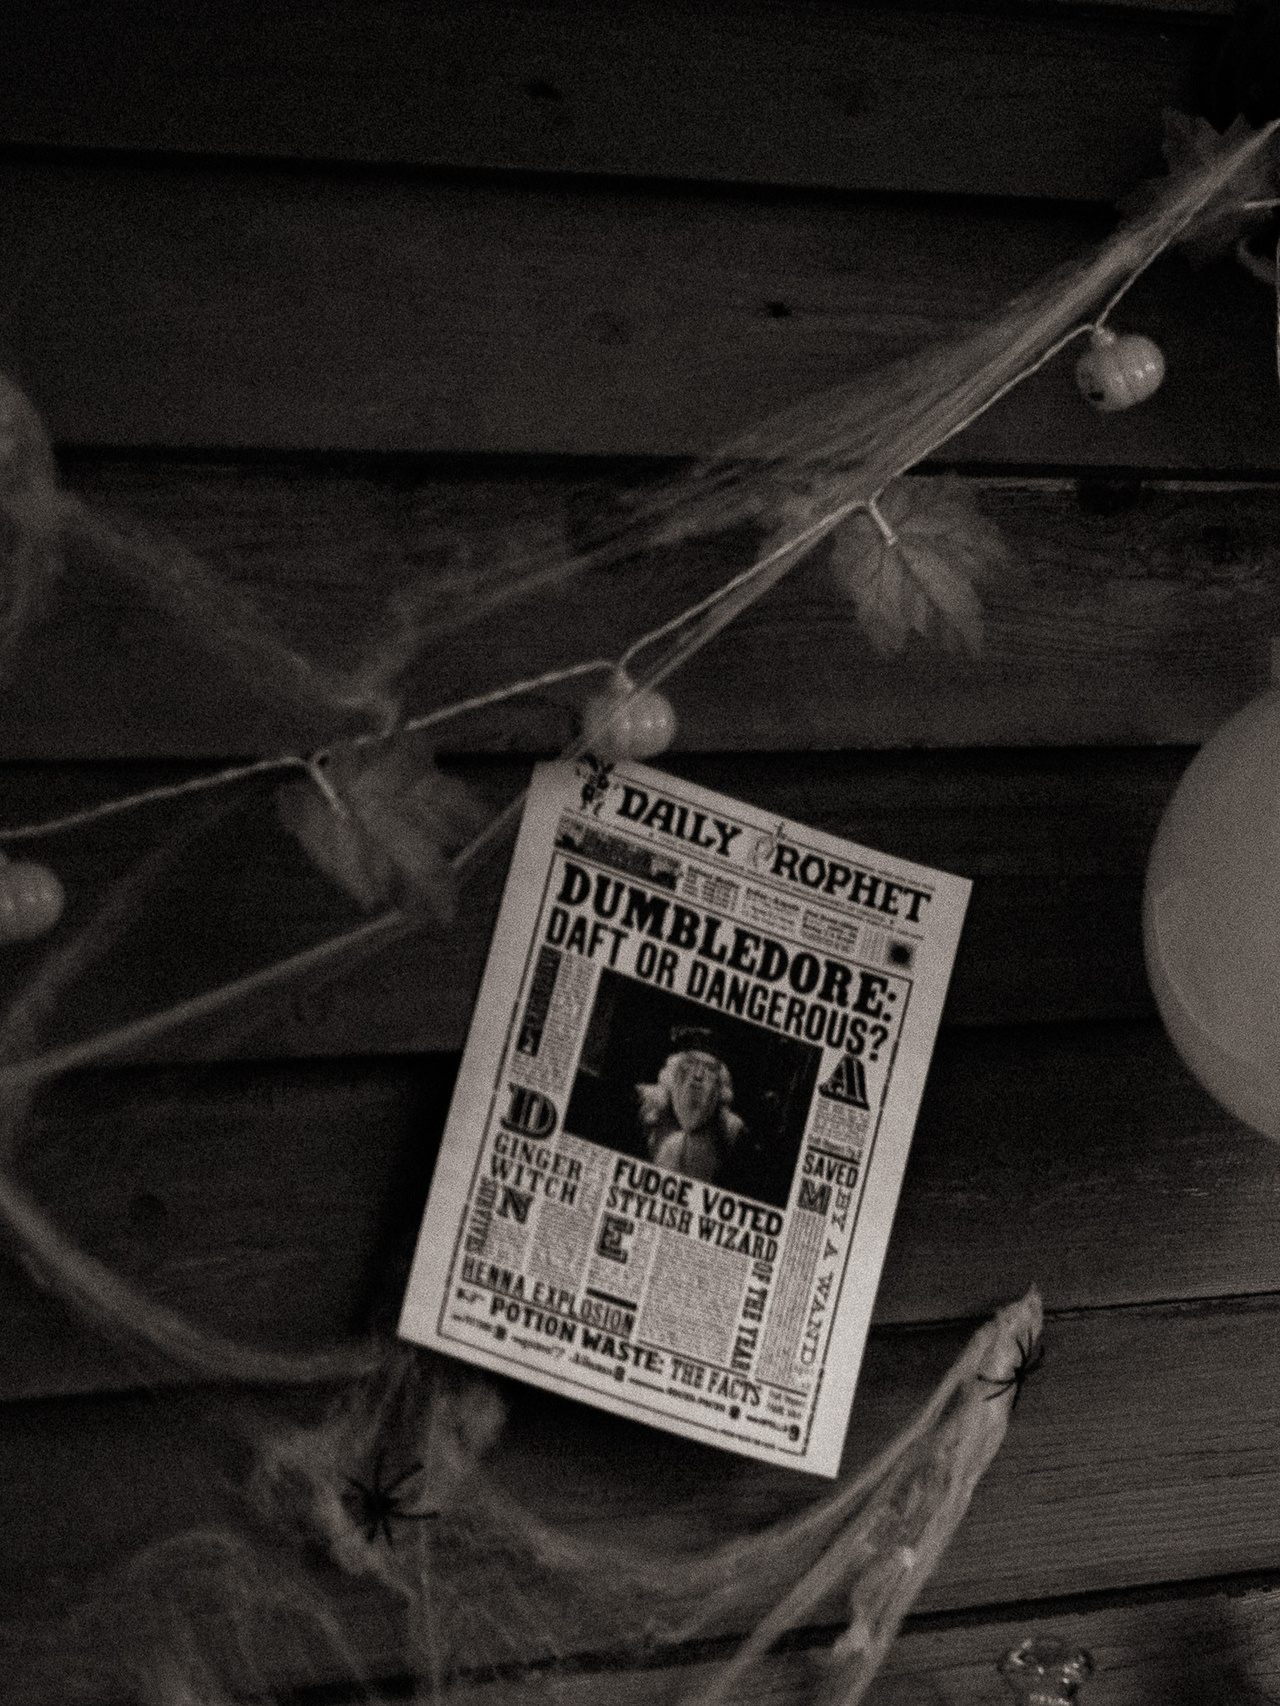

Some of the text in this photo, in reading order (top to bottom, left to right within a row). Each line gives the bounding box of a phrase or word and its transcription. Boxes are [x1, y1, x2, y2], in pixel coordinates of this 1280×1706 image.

[616, 784, 743, 857] DAILY
[556, 861, 897, 1024] DUMBLEDORE:
[544, 906, 889, 1062] DAFT OR DANGEROUS?
[489, 1153, 578, 1204] WITCH
[493, 1131, 584, 1182] GINGER
[802, 1152, 860, 1189] SAVED
[605, 1185, 780, 1263] STYLISH WIZARD
[612, 1157, 784, 1237] FUDGE VOTED
[461, 1257, 526, 1301] HENNA
[532, 1280, 637, 1337] EXPLOSION
[490, 1296, 578, 1343] POTION
[581, 1328, 665, 1374] WASTE:
[669, 1356, 709, 1389] THE
[707, 1370, 762, 1407] FACTS
